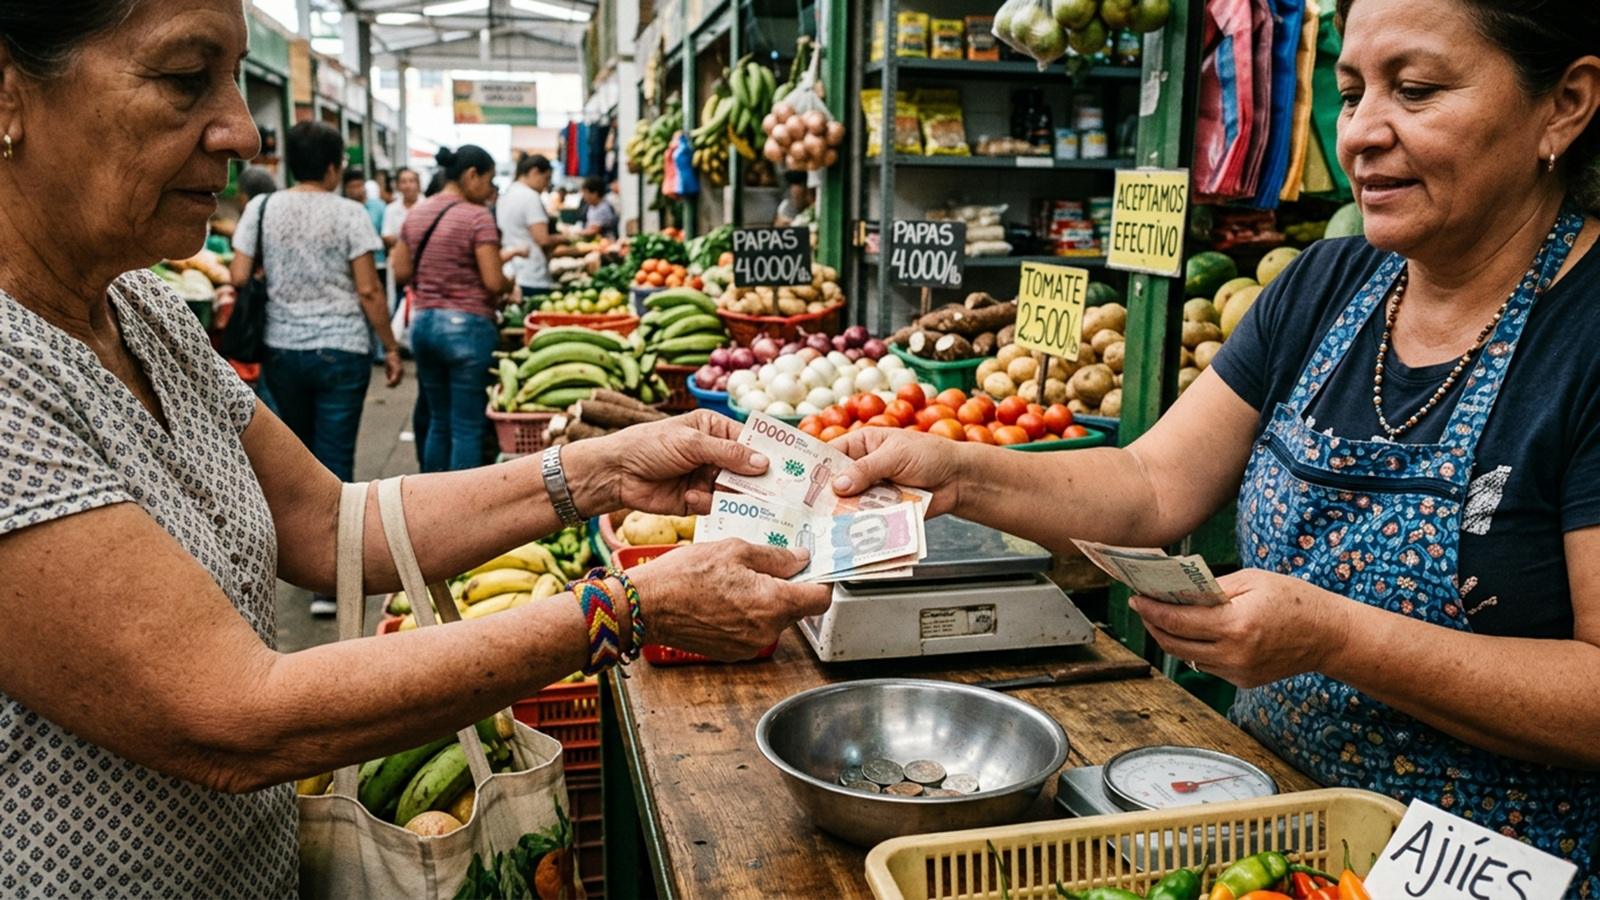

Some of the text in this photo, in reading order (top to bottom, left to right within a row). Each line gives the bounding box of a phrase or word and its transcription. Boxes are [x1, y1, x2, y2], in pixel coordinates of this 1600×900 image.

[1117, 183, 1185, 213] ACEPTAMOS
[733, 229, 799, 252] PAPAS
[893, 220, 954, 246] PAPAS
[1024, 267, 1083, 305] TOMATE
[752, 417, 796, 447] 10000
[719, 499, 759, 518] 2000
